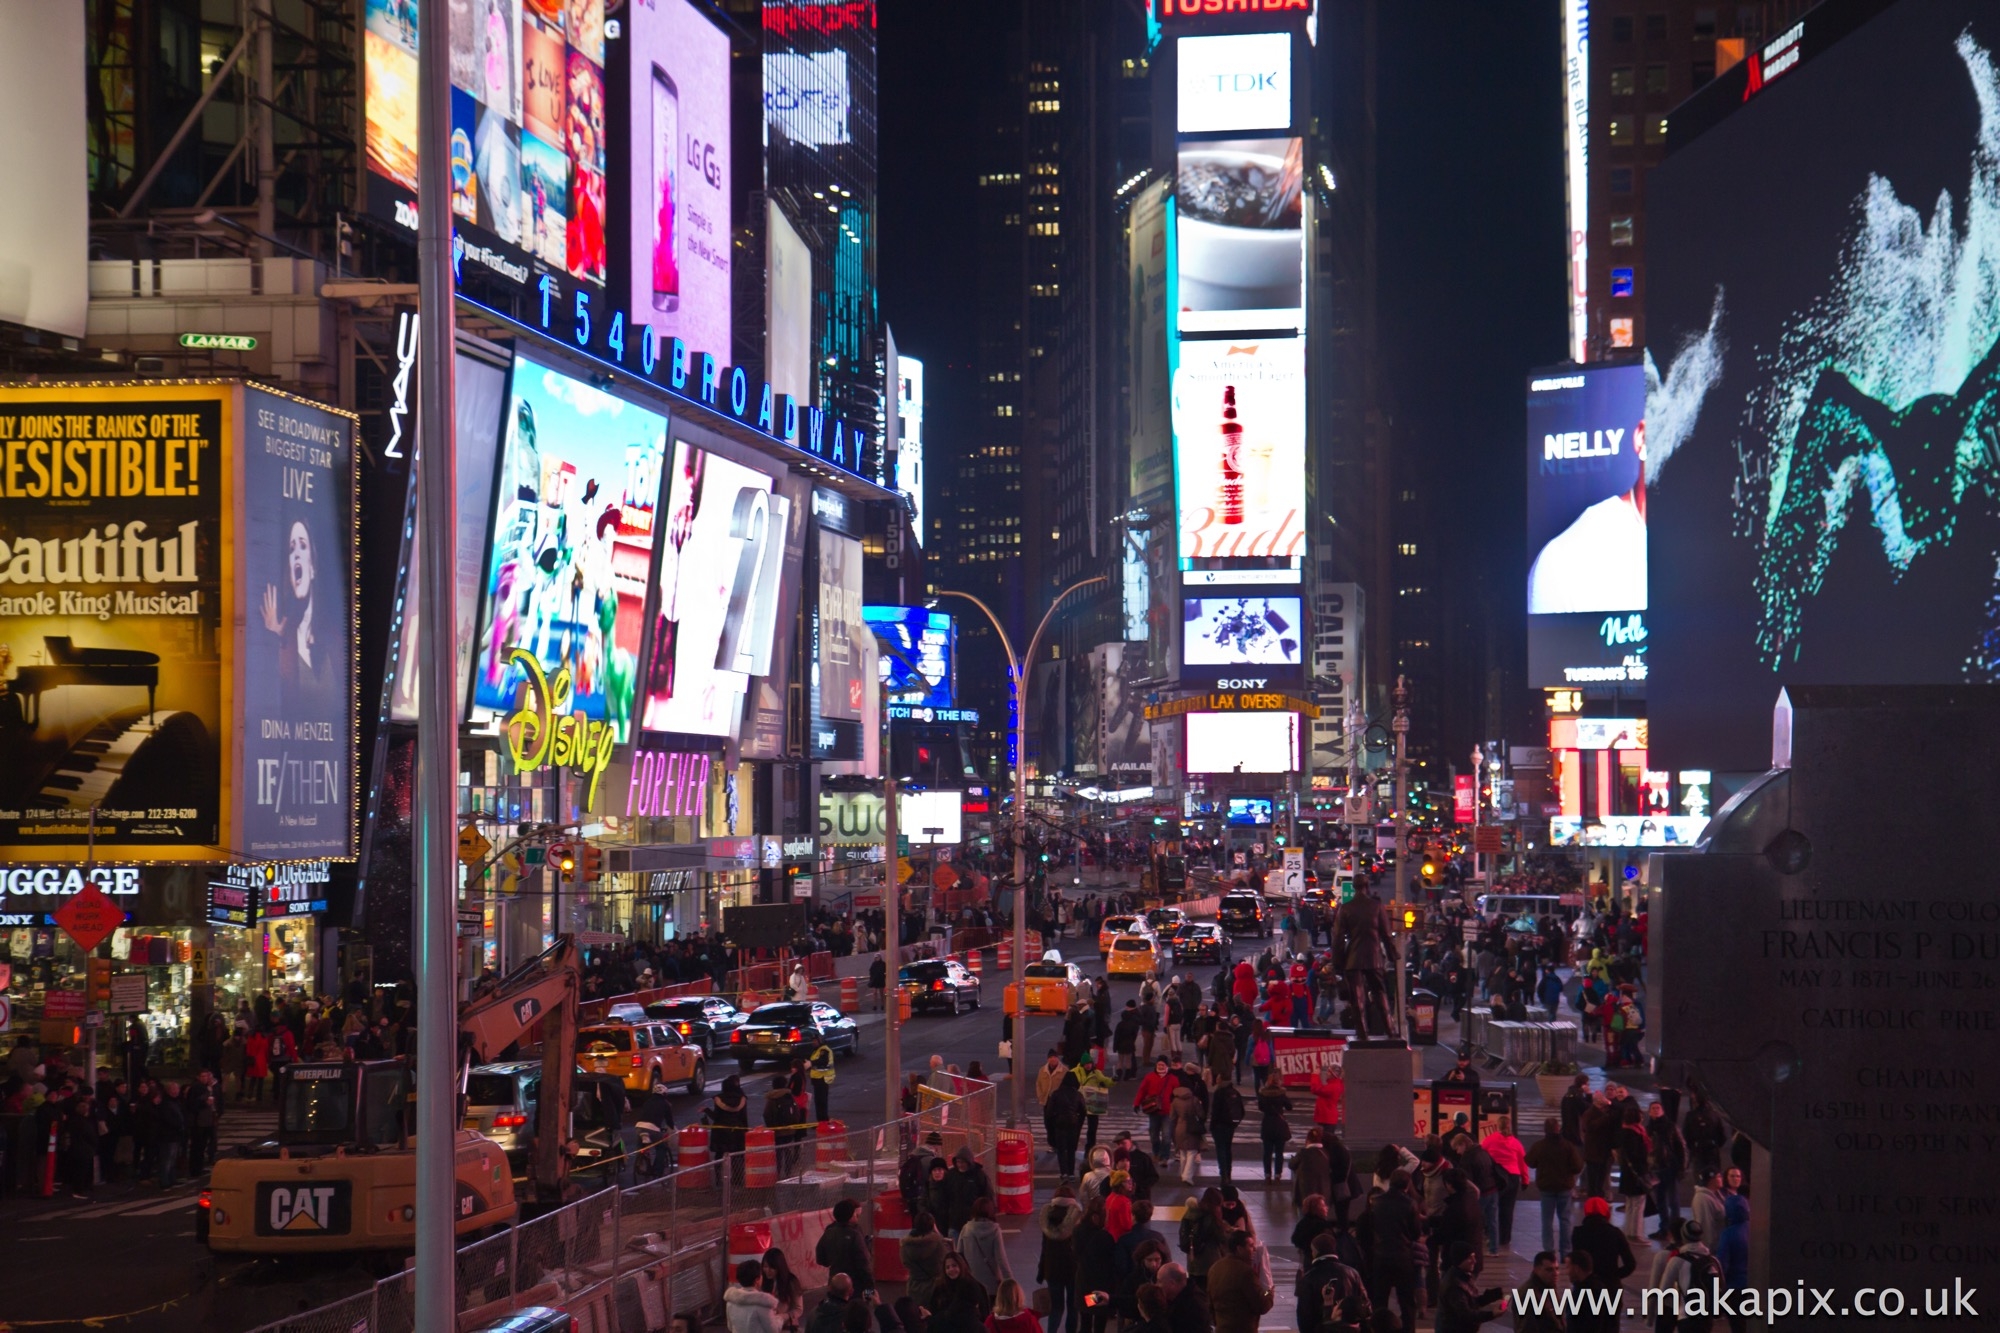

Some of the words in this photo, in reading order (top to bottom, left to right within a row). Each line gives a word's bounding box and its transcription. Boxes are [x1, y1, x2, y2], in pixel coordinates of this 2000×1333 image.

[1209, 71, 1277, 92] TDK
[687, 133, 700, 171] LG
[703, 143, 721, 190] G3
[687, 204, 706, 232] Simple
[687, 237, 698, 255] the
[699, 241, 711, 263] New
[186, 334, 251, 349] LAMAR
[18, 416, 63, 438] JOINS
[64, 415, 93, 438] THE
[96, 415, 147, 438] RANKS
[151, 414, 170, 437] OF
[171, 414, 200, 437] THE
[258, 409, 275, 430] SEE
[279, 415, 340, 448] BROADWAY'S
[265, 435, 306, 462] BIGGEST
[310, 447, 332, 469] STAR
[1544, 428, 1625, 460] NELLY
[283, 466, 314, 503] LIVE
[886, 509, 899, 569] 1500
[58, 591, 111, 621] King
[114, 590, 199, 615] Musical
[1314, 593, 1344, 666] CALL
[1325, 662, 1338, 673] OF
[1217, 678, 1268, 690] SONY
[1210, 693, 1235, 709] LAX
[936, 710, 960, 721] THE
[261, 719, 290, 740] IDINA
[295, 721, 334, 742] MENZEL
[626, 750, 710, 817] FOREVER
[147, 809, 197, 819] 212-239-6200
[274, 861, 330, 885] LUGGAGE
[1286, 860, 1301, 870] 25
[289, 902, 311, 913] SONY
[468, 913, 480, 921] WAY
[1780, 900, 1920, 921] LIEUTENANT
[72, 924, 104, 932] AHEAD
[1761, 931, 1902, 960] FRANCIS
[1950, 932, 2000, 961] DU
[193, 951, 203, 980] ATM
[1779, 970, 1824, 988] MAY
[1831, 970, 1842, 988] 2
[520, 1000, 533, 1024] CAT
[1802, 1008, 1925, 1030] CATHOLIC
[1940, 1010, 1996, 1031] PRIE
[1275, 1052, 1319, 1075] JERSEY
[1857, 1068, 1976, 1089] CHAPLAIN
[1804, 1102, 1867, 1121] 165TH
[1834, 1133, 1883, 1151] OLD
[1892, 1134, 1945, 1152] 69TH
[270, 1187, 335, 1230] CAT
[461, 1196, 473, 1215] CAT
[1836, 1194, 1886, 1213] LIFE
[1896, 1195, 1927, 1214] OF
[1901, 1222, 1941, 1237] FOR
[1800, 1241, 1857, 1260] GOD
[1865, 1242, 1918, 1262] AND
